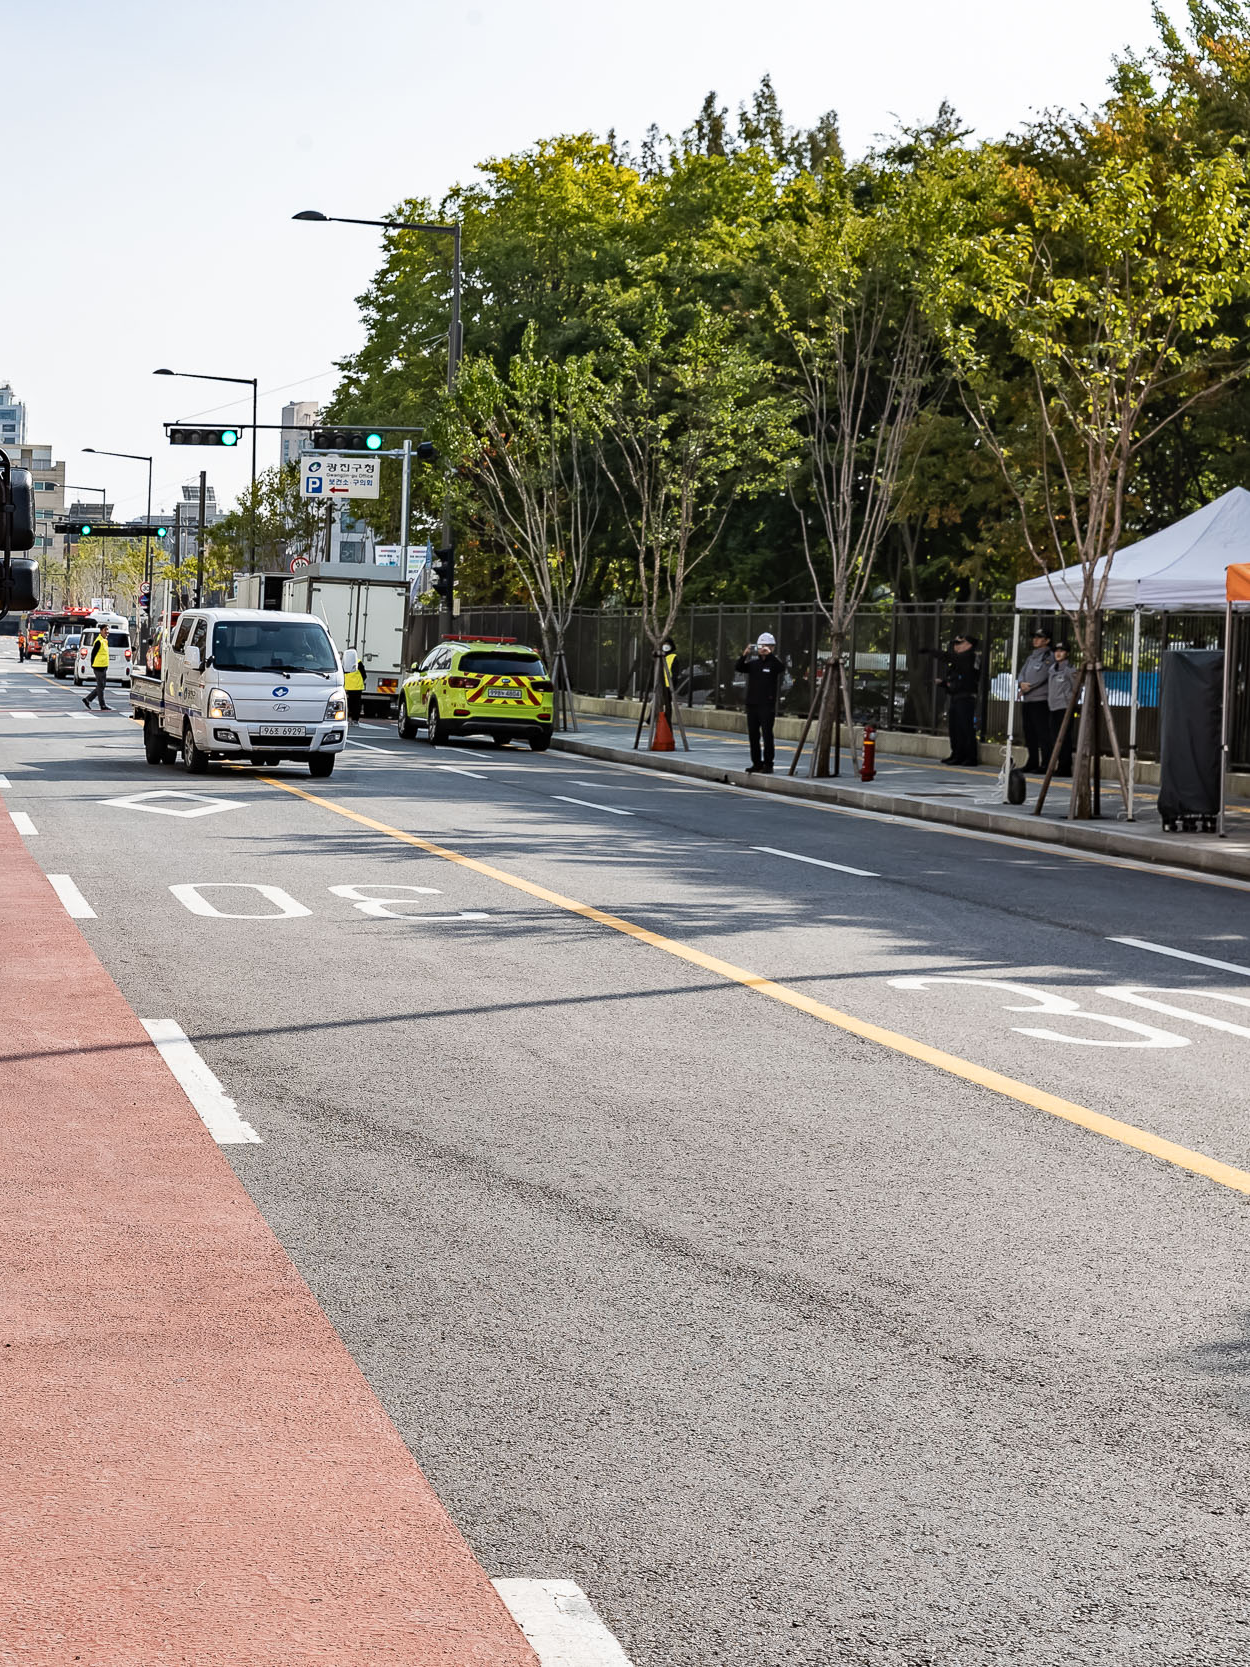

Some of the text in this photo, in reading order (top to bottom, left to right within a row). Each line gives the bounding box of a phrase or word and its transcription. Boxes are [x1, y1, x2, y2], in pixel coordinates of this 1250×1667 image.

[326, 463, 375, 473] 광진구청
[308, 478, 320, 493] P
[282, 727, 302, 736] 6929
